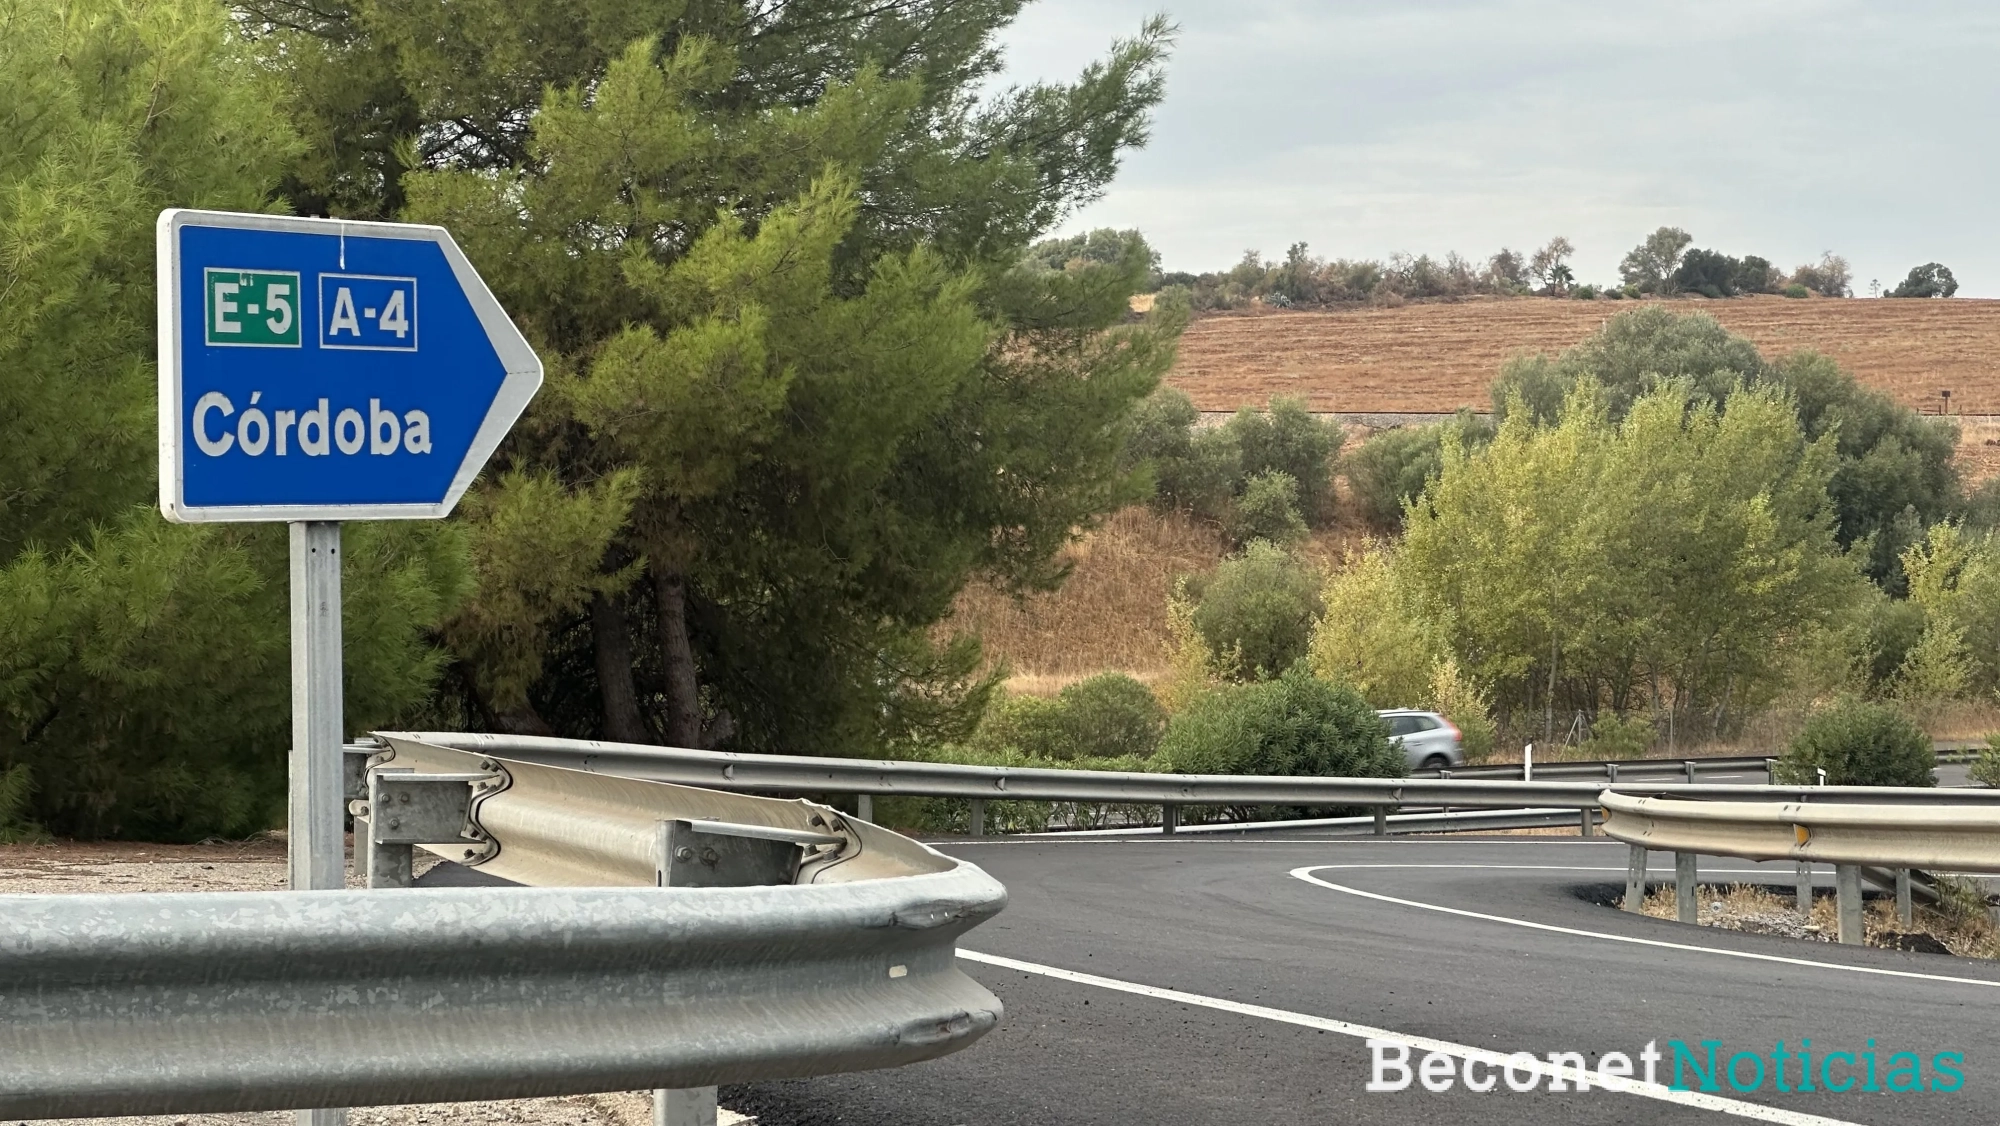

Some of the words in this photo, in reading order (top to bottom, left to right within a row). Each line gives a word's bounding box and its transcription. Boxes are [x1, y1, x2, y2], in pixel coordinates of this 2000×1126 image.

[214, 281, 293, 335] E-5
[329, 287, 409, 339] A-4
[192, 391, 432, 457] Córdoba
